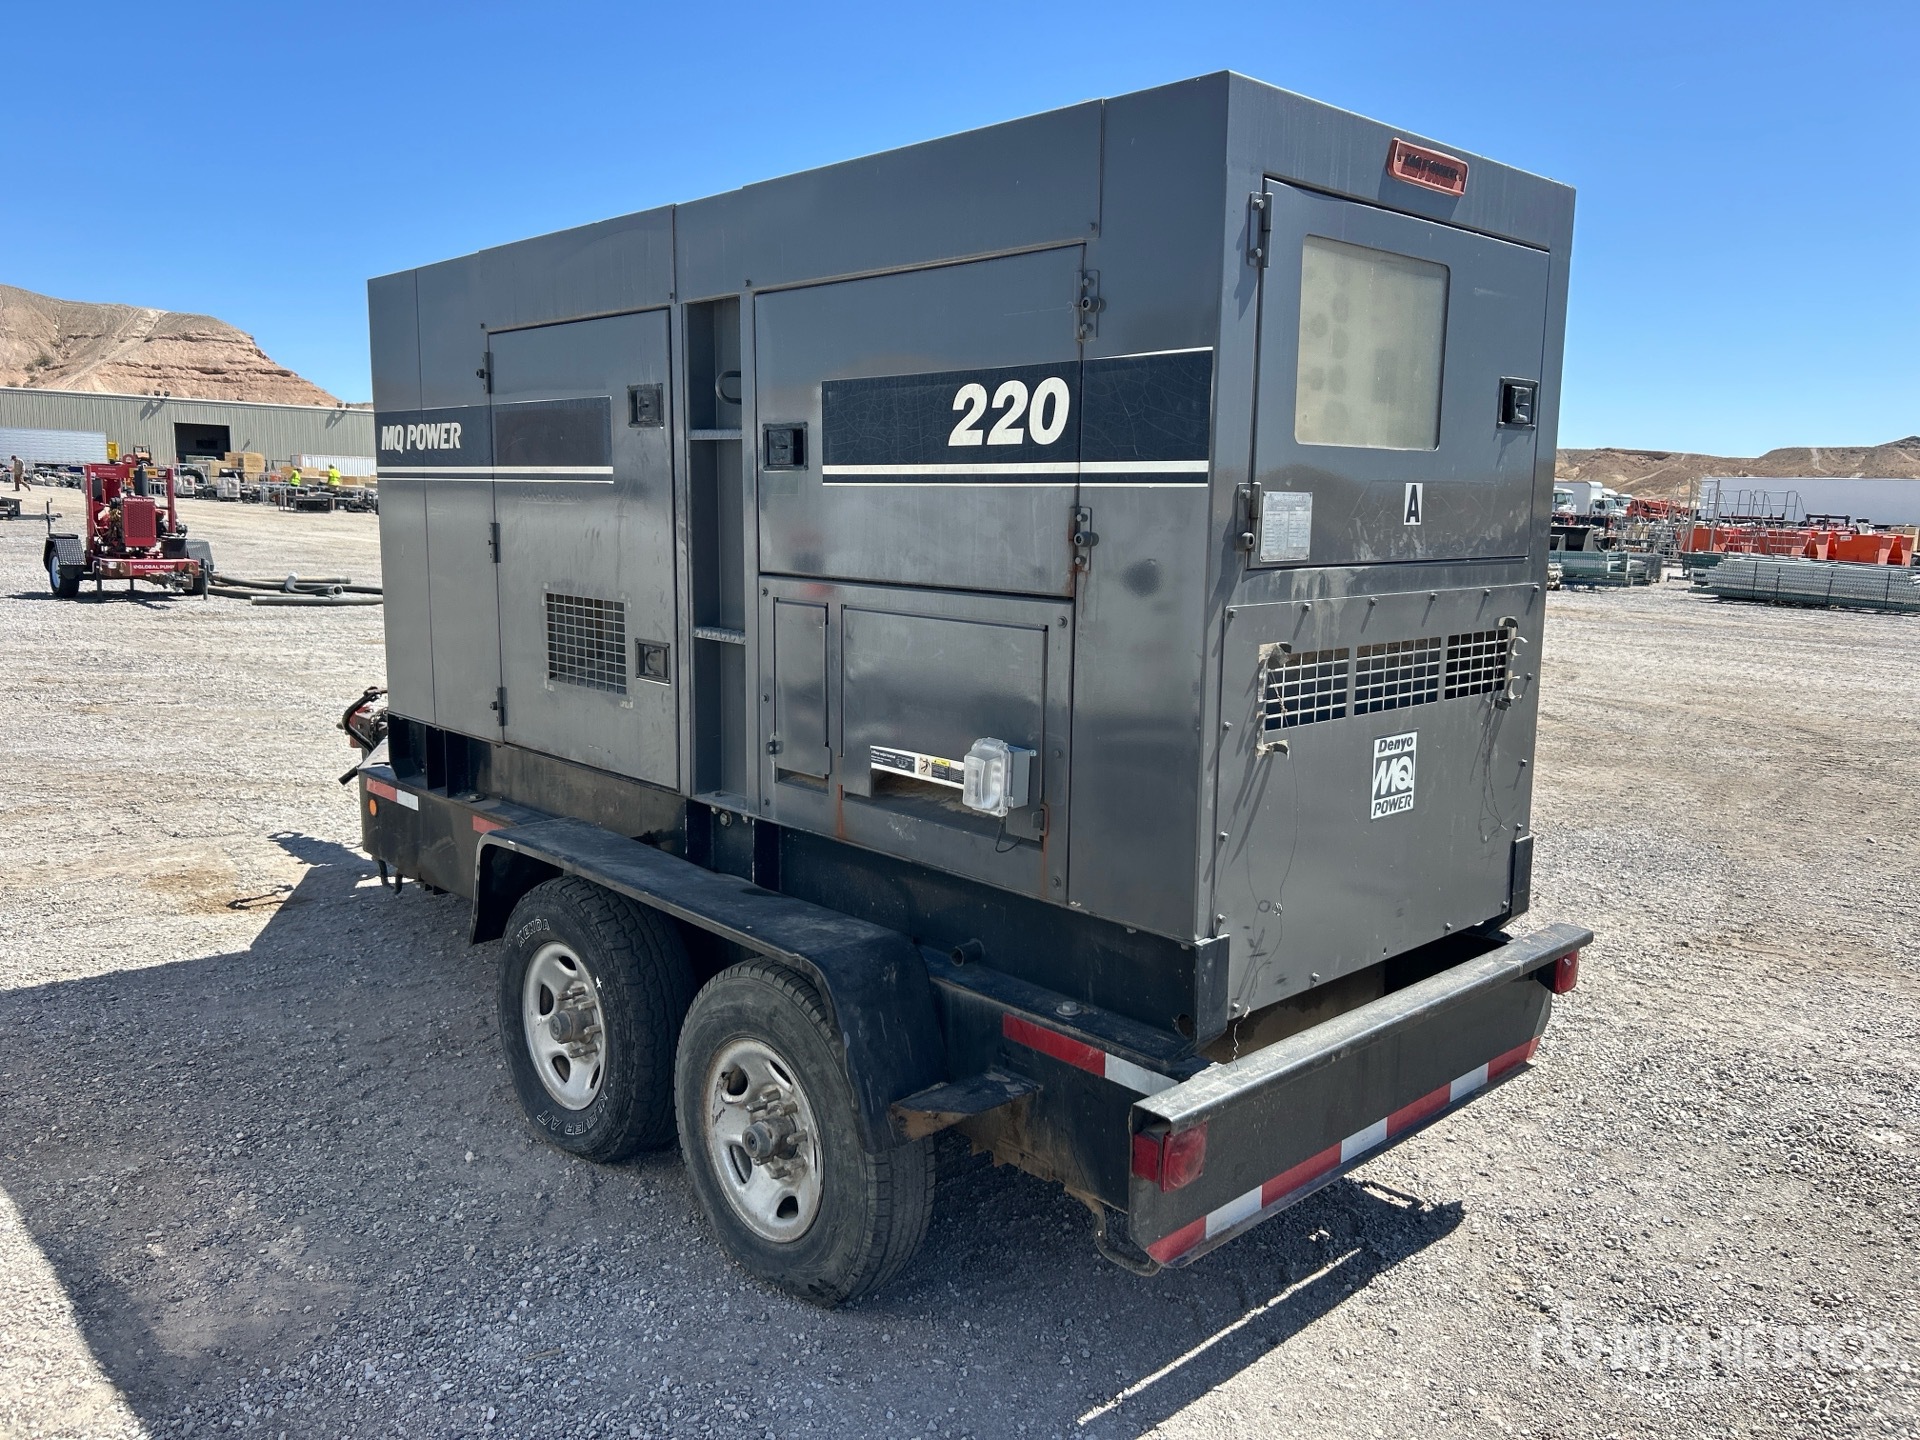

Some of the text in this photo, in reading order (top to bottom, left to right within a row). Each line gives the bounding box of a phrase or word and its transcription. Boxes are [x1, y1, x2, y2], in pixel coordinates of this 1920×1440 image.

[948, 376, 1070, 446] 220
[381, 422, 461, 455] MQ POWER
[1405, 484, 1420, 523] A
[1378, 736, 1413, 753] Denyo
[1373, 794, 1412, 817] POWER
[516, 918, 550, 948] KENDA
